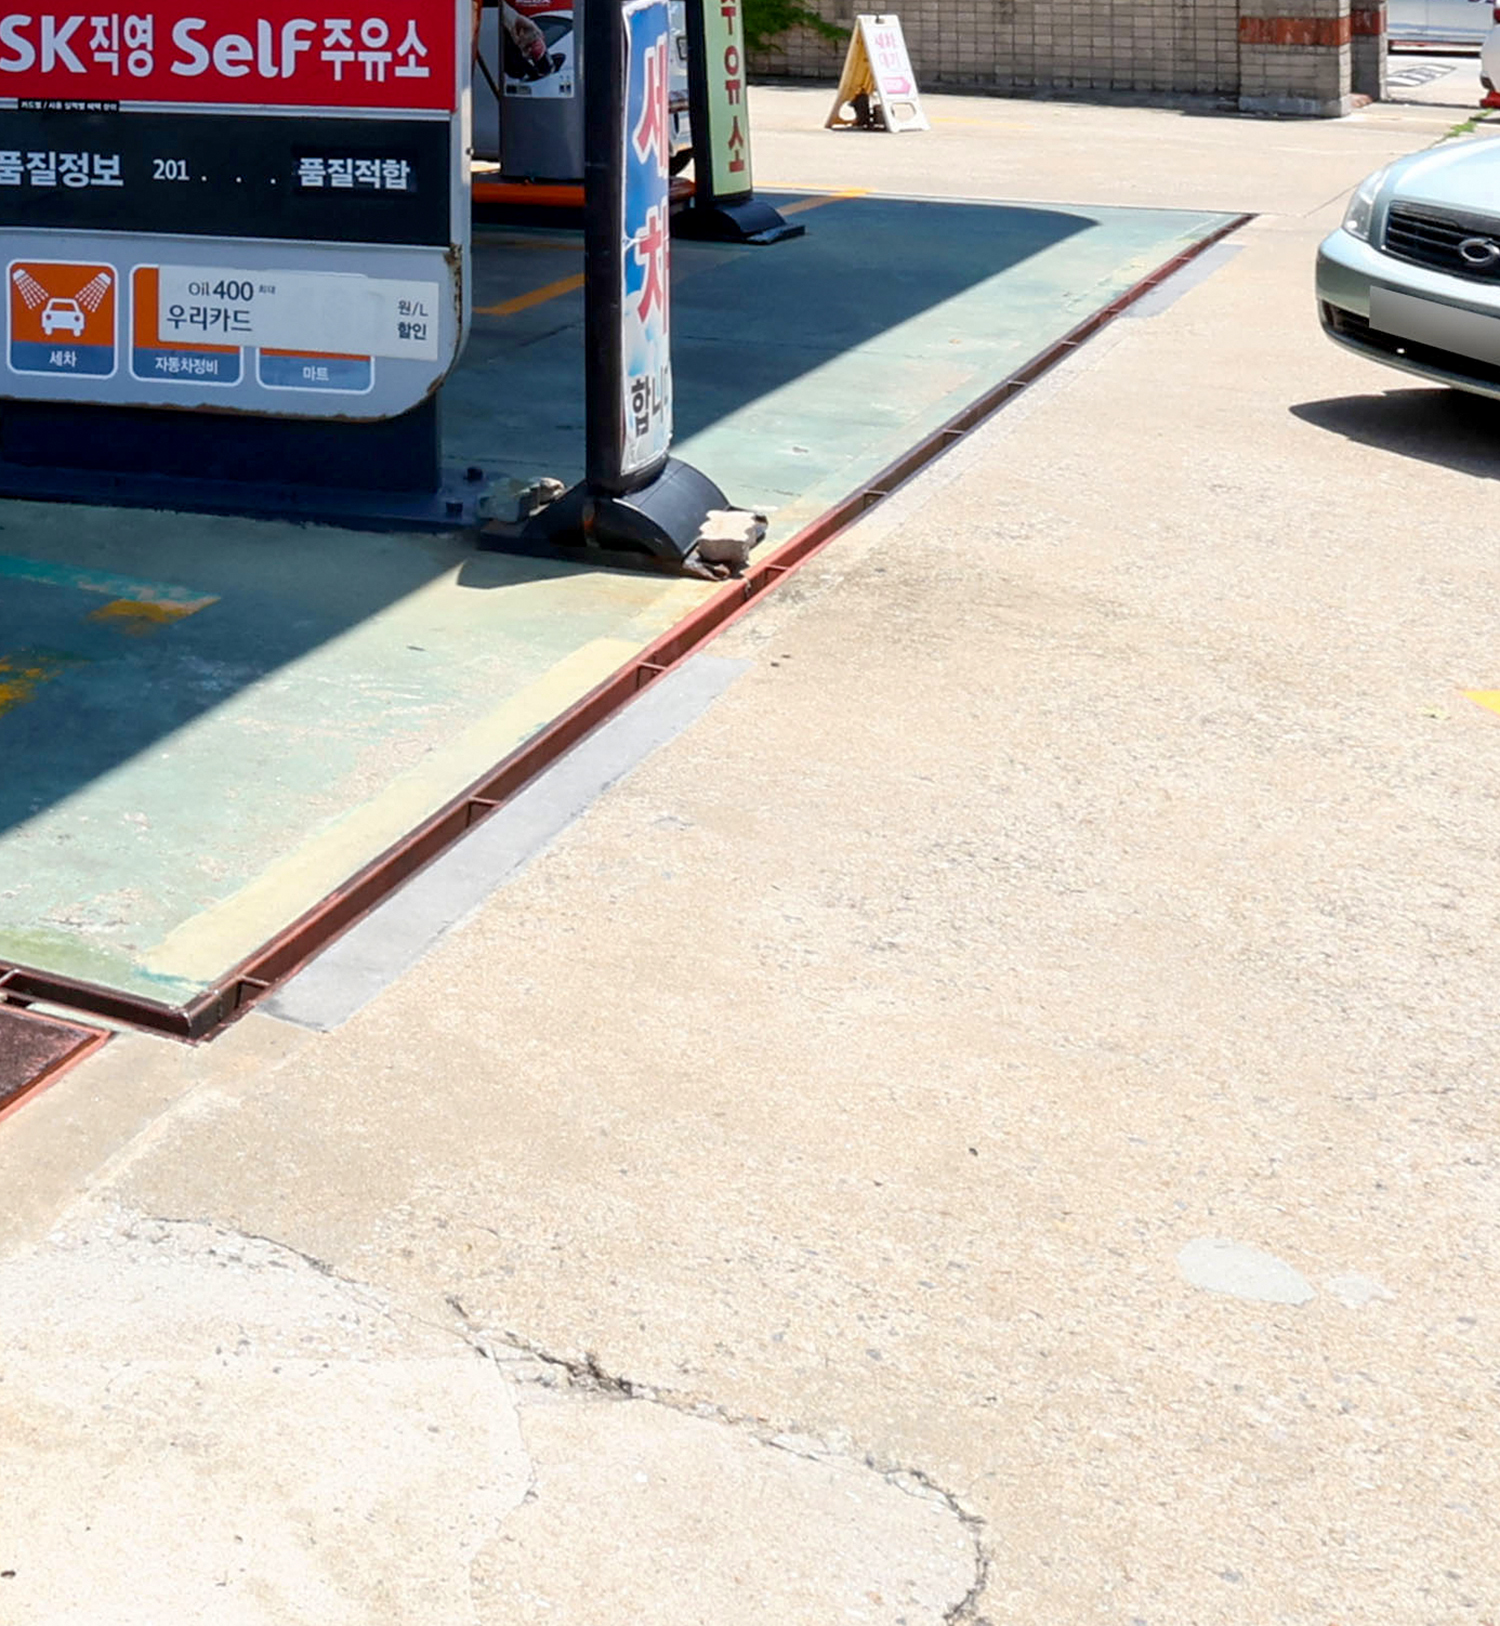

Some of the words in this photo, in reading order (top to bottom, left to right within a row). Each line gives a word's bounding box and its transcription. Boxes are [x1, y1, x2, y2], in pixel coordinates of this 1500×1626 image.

[298, 157, 410, 191] 품질적합
[166, 304, 253, 333] 우리카드
[396, 321, 428, 342] 할인
[48, 349, 78, 368] 세차
[154, 356, 219, 376] 자동차정비
[302, 365, 330, 382] 마트
[630, 369, 669, 436] 합니
